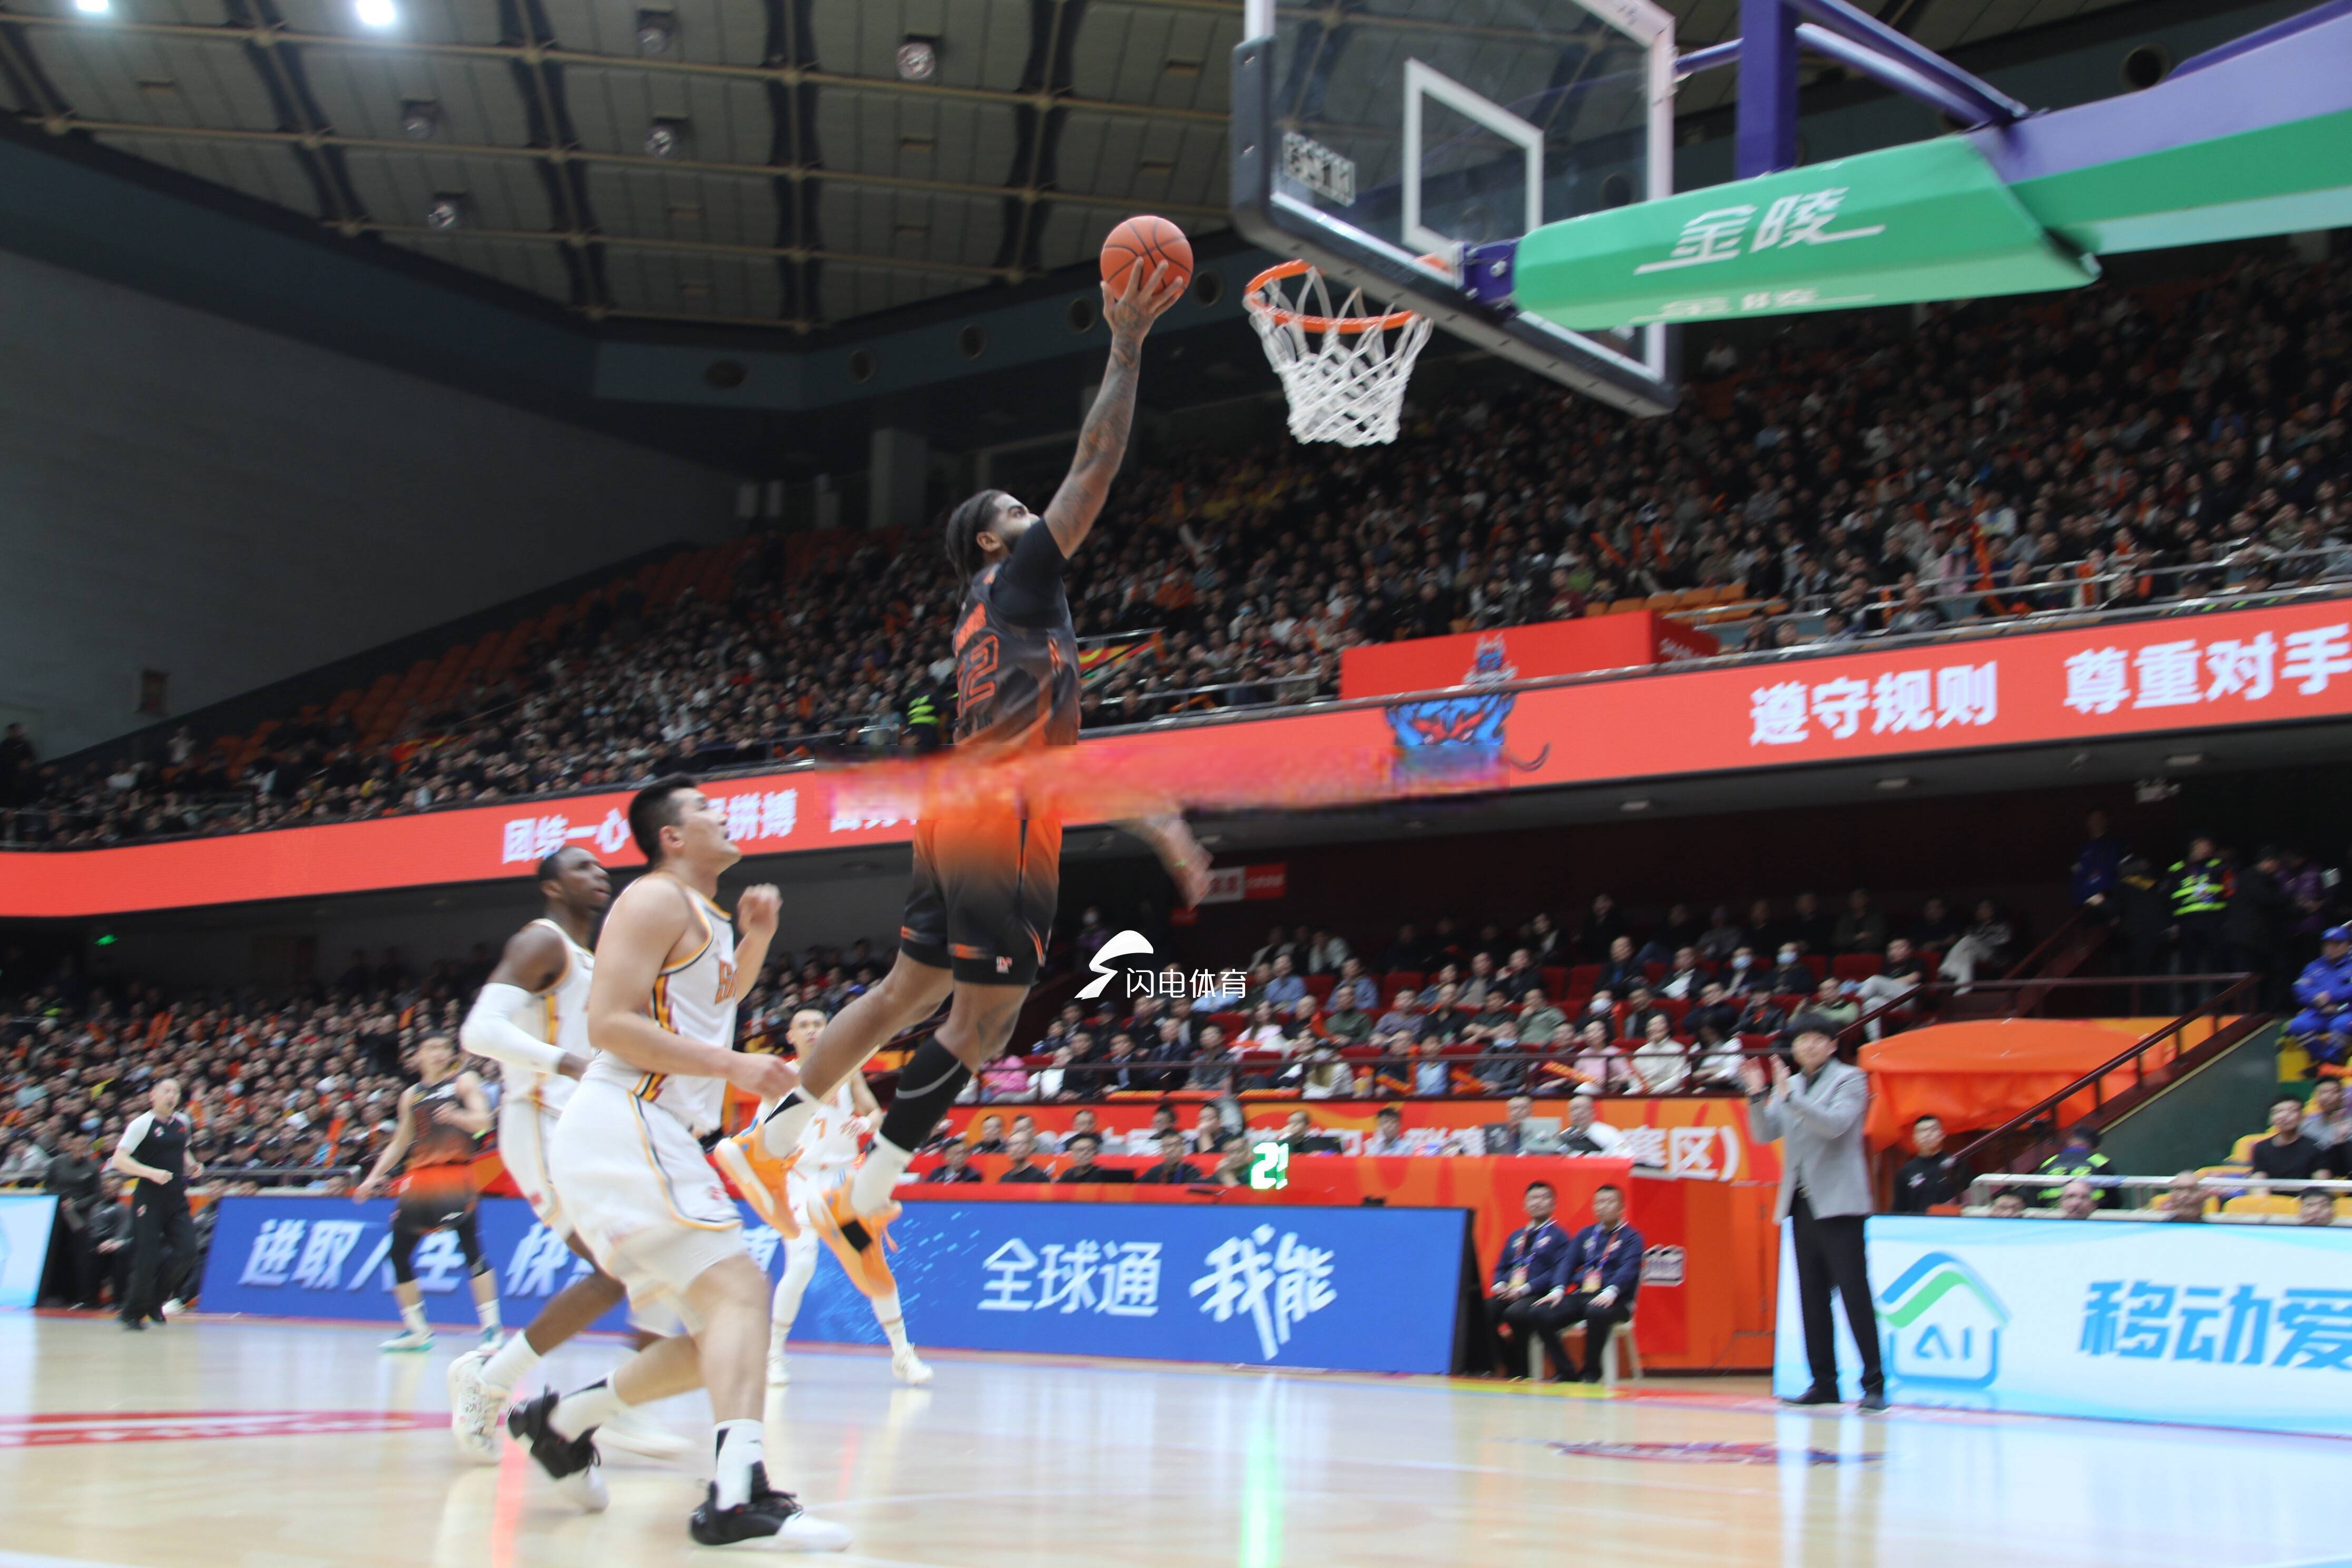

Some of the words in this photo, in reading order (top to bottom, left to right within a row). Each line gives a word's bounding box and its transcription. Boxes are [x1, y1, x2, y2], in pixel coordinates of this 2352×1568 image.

[1633, 187, 1886, 275] 金陵
[1750, 660, 1997, 747] 遵守规则
[2063, 623, 2352, 714] 尊重对手
[976, 1237, 1163, 1317] 全球通
[1189, 1223, 1337, 1361] 我能
[2079, 1280, 2352, 1370] 移动爱
[1915, 1324, 1971, 1361] AI
